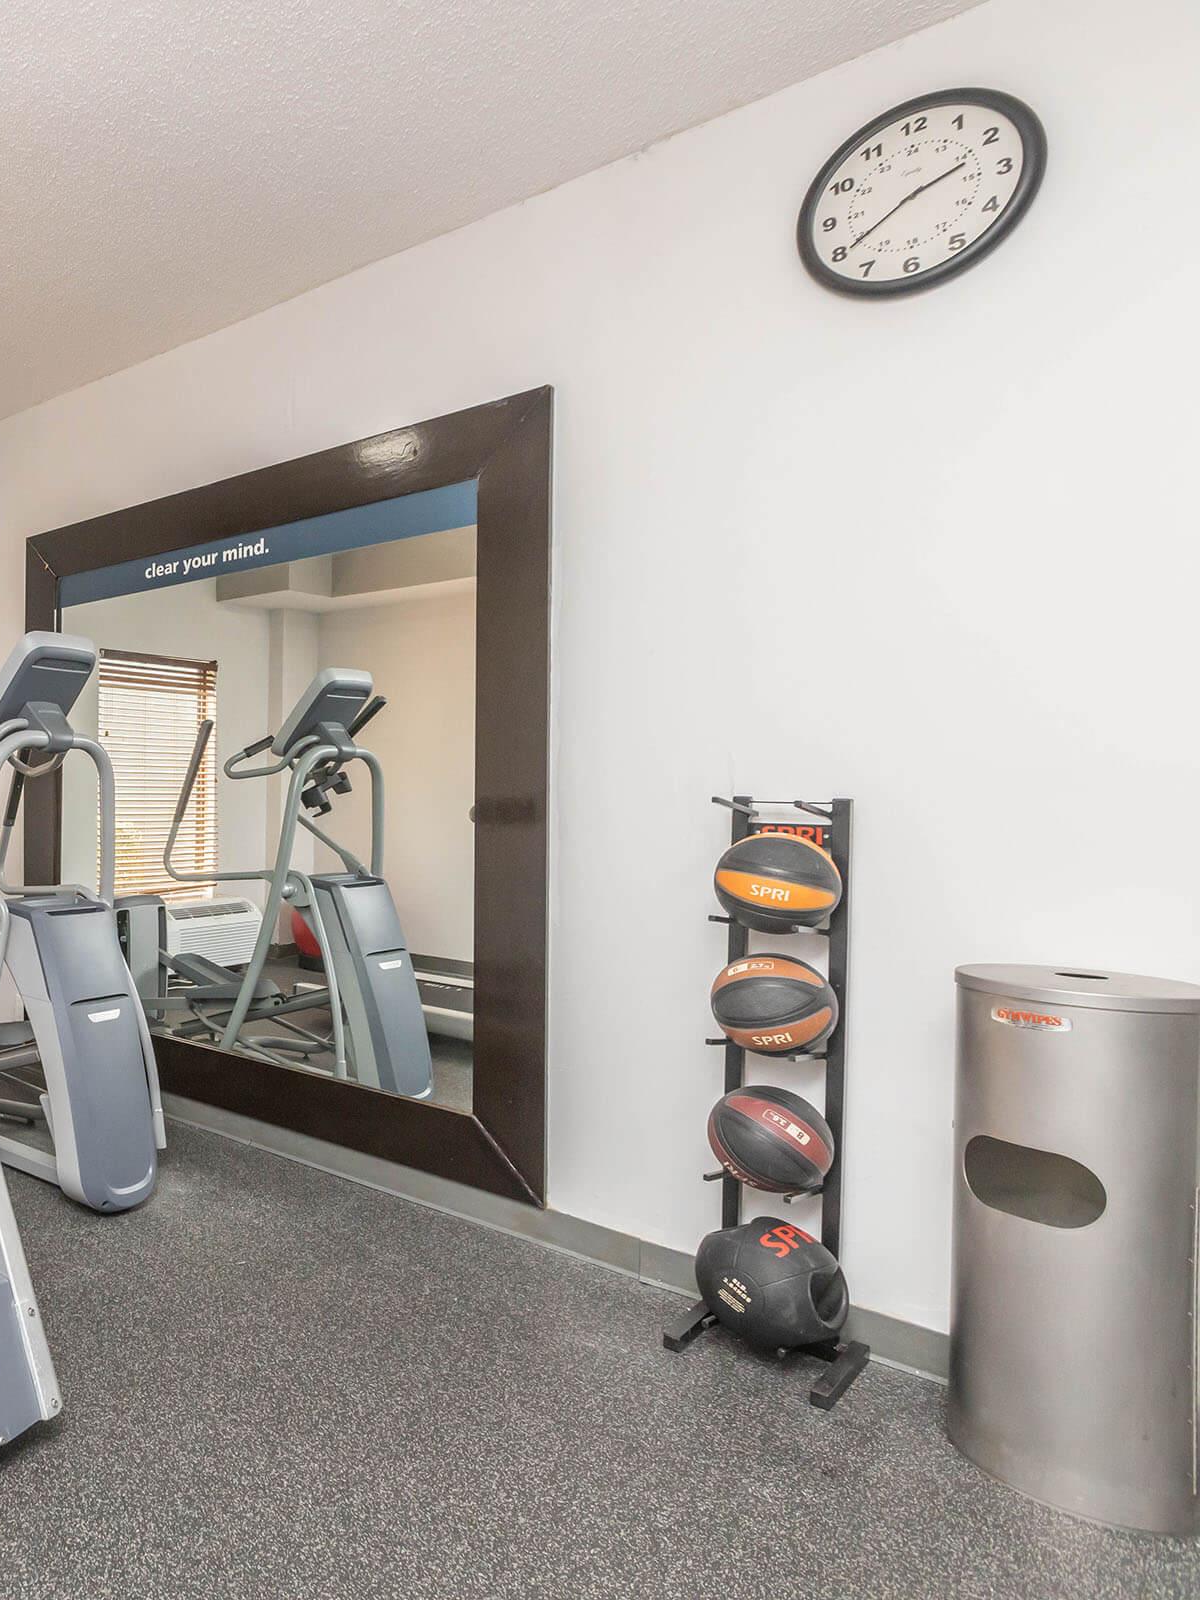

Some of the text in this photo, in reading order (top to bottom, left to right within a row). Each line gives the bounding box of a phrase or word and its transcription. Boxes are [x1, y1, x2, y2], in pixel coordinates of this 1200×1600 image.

[900, 116, 928, 137] 12
[951, 114, 964, 131] 1
[982, 127, 1000, 146] 2
[860, 143, 882, 162] 11
[995, 157, 1014, 175] 3
[829, 177, 855, 196] 10
[981, 195, 1001, 213] 4
[822, 217, 837, 232] 9
[948, 232, 966, 251] 5
[831, 246, 848, 263] 8
[858, 260, 877, 278] 7
[902, 257, 921, 274] 6
[145, 538, 270, 579] clear your mind.
[749, 884, 791, 902] SPRI
[751, 1032, 793, 1046] SPRI
